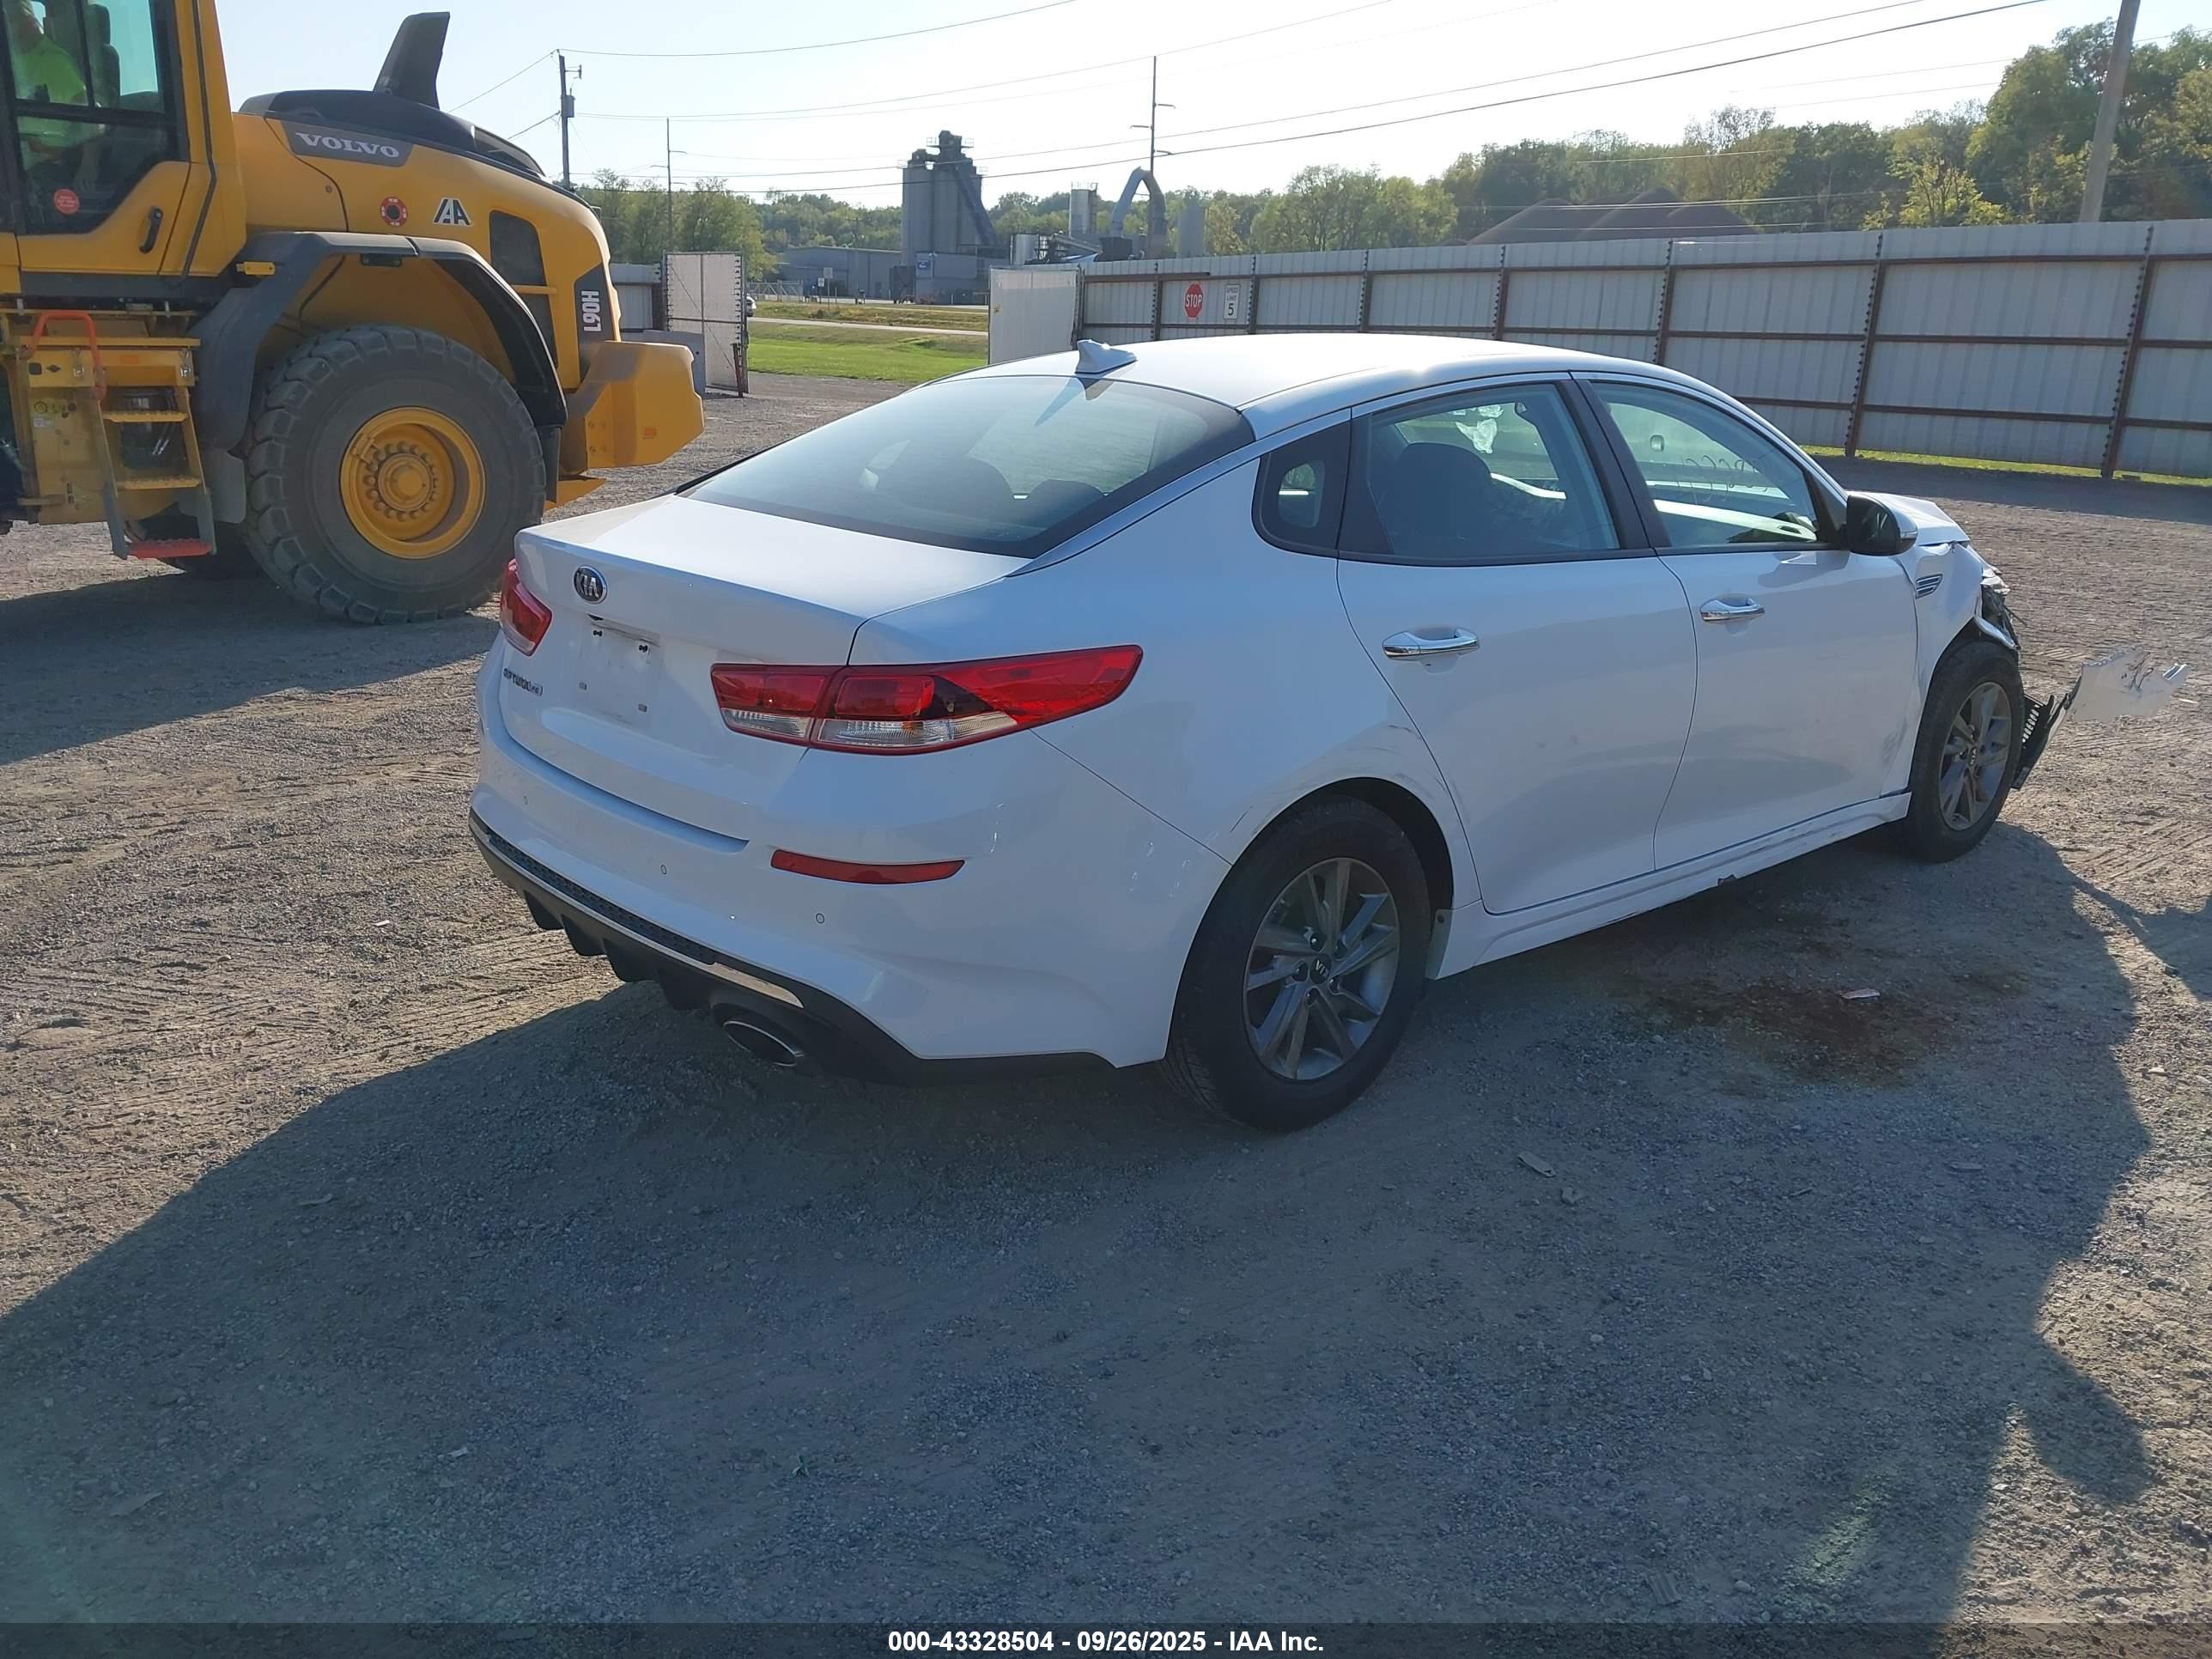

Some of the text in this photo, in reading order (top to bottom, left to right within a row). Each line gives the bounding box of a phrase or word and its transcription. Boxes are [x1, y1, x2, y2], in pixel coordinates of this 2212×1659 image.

[295, 132, 399, 158] VOLVO
[581, 290, 601, 331] L90H
[1185, 294, 1202, 307] STOP
[1228, 302, 1235, 316] 5
[576, 571, 599, 599] KIA
